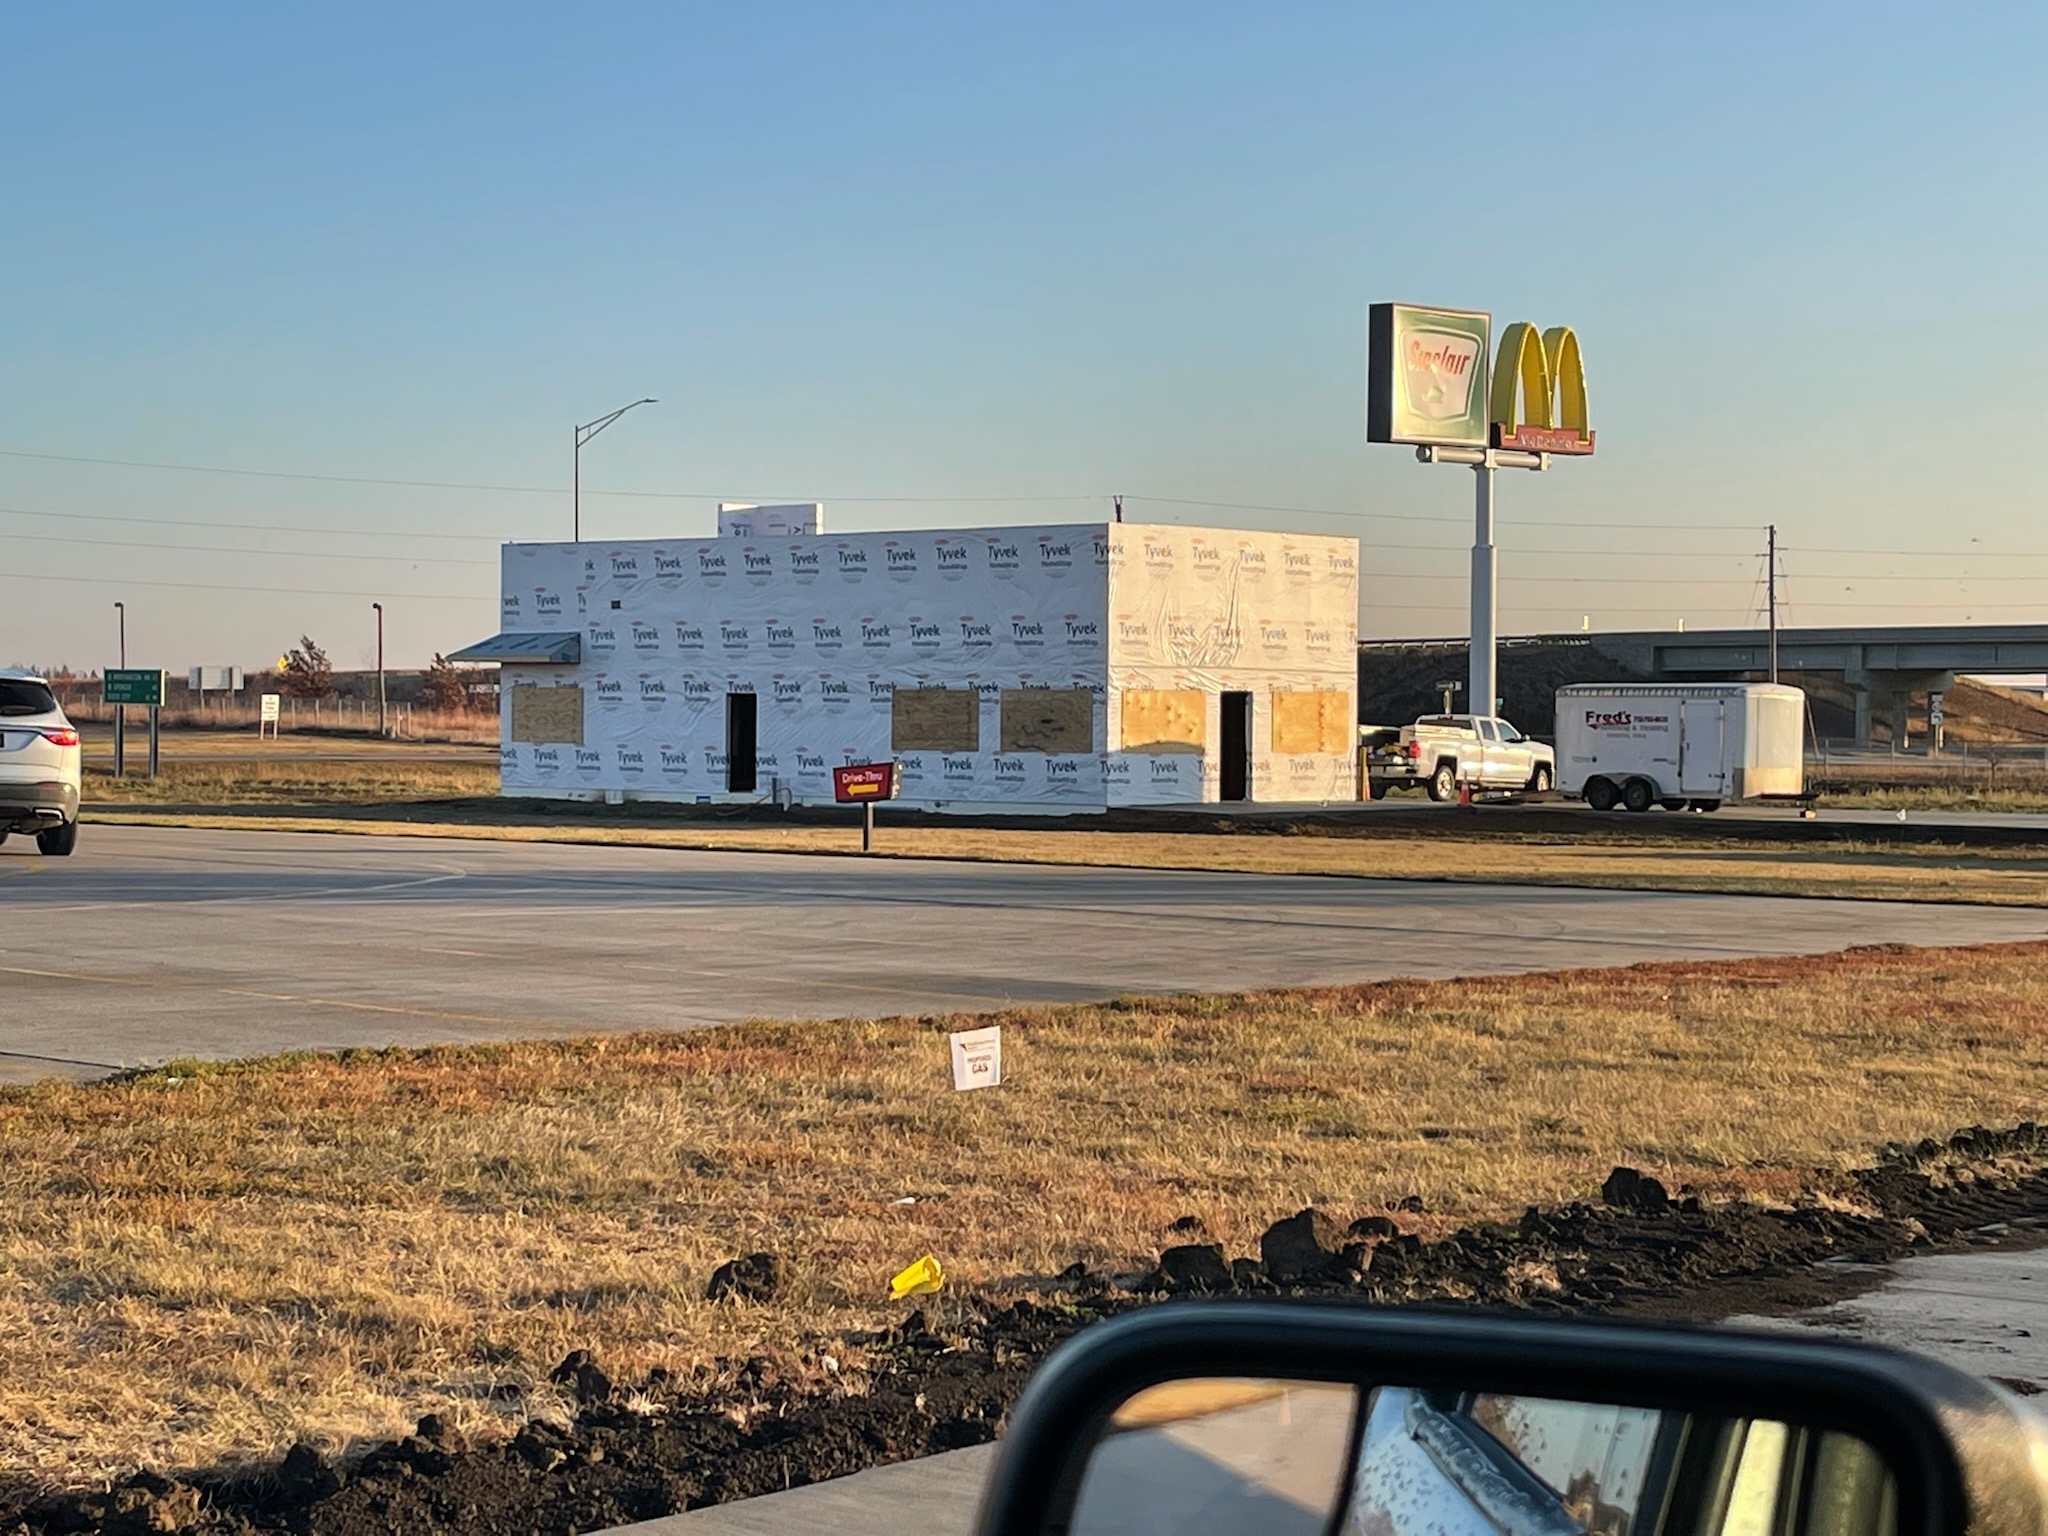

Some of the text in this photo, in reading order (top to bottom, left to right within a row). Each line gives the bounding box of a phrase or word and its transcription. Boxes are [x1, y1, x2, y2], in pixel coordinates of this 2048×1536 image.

[1409, 340, 1470, 375] Sinclair
[936, 547, 967, 561] Tyvek
[987, 545, 1018, 559] Tyvek
[1040, 543, 1070, 558] Tyvek
[1094, 542, 1124, 555] Tyvek
[1145, 544, 1173, 558] Tyvek
[1193, 547, 1220, 560] Tyvek
[699, 555, 726, 567] Tyvek
[744, 554, 772, 566] Tyvek
[791, 552, 818, 565] Tyvek
[838, 550, 867, 563] Tyvek
[886, 549, 916, 562] Tyvek
[1240, 550, 1266, 562] Tyvek
[1285, 553, 1310, 566] Tyvek
[1328, 555, 1354, 568] Tyvek
[612, 559, 637, 570] Tyvek
[655, 557, 682, 569] Tyvek
[504, 596, 520, 607] vek
[536, 594, 560, 606] Tyvek
[590, 629, 615, 640] Tyvek
[632, 628, 659, 640] Tyvek
[676, 628, 704, 640] Tyvek
[721, 628, 749, 640] Tyvek
[767, 627, 794, 639] Tyvek
[814, 626, 842, 639] Tyvek
[862, 625, 890, 638] Tyvek
[910, 624, 940, 637] Tyvek
[961, 624, 991, 637] Tyvek
[1012, 623, 1044, 636] Tyvek
[1066, 622, 1098, 636] Tyvek
[1120, 622, 1148, 635] Tyvek
[1261, 627, 1288, 640] Tyvek
[1305, 629, 1330, 641] Tyvek
[596, 681, 621, 693] Tyvek
[639, 681, 664, 692] Tyvek
[683, 681, 710, 693] Tyvek
[729, 681, 754, 692] Tyvek
[774, 681, 801, 693] Tyvek
[821, 681, 848, 694] Tyvek
[869, 681, 896, 693] Tyvek
[1586, 711, 1631, 725] Fred's
[501, 749, 517, 759] vek
[534, 749, 558, 762] Tyvek
[575, 750, 600, 763] Tyvek
[618, 750, 643, 763] Tyvek
[661, 752, 687, 764] Tyvek
[706, 753, 726, 766] Tyve
[756, 754, 778, 767] yvek
[796, 755, 824, 768] Tyvek
[943, 757, 972, 771] Tyvek
[993, 758, 1024, 771] Tyvek
[1045, 760, 1077, 773] Tyvek
[1100, 760, 1129, 775] Tyvek
[1150, 760, 1178, 773] Tyvek
[1198, 760, 1218, 773] Tyve
[1289, 760, 1315, 772] Tyvek
[842, 771, 883, 783] Drive-Thru
[972, 1064, 988, 1074] GAS
